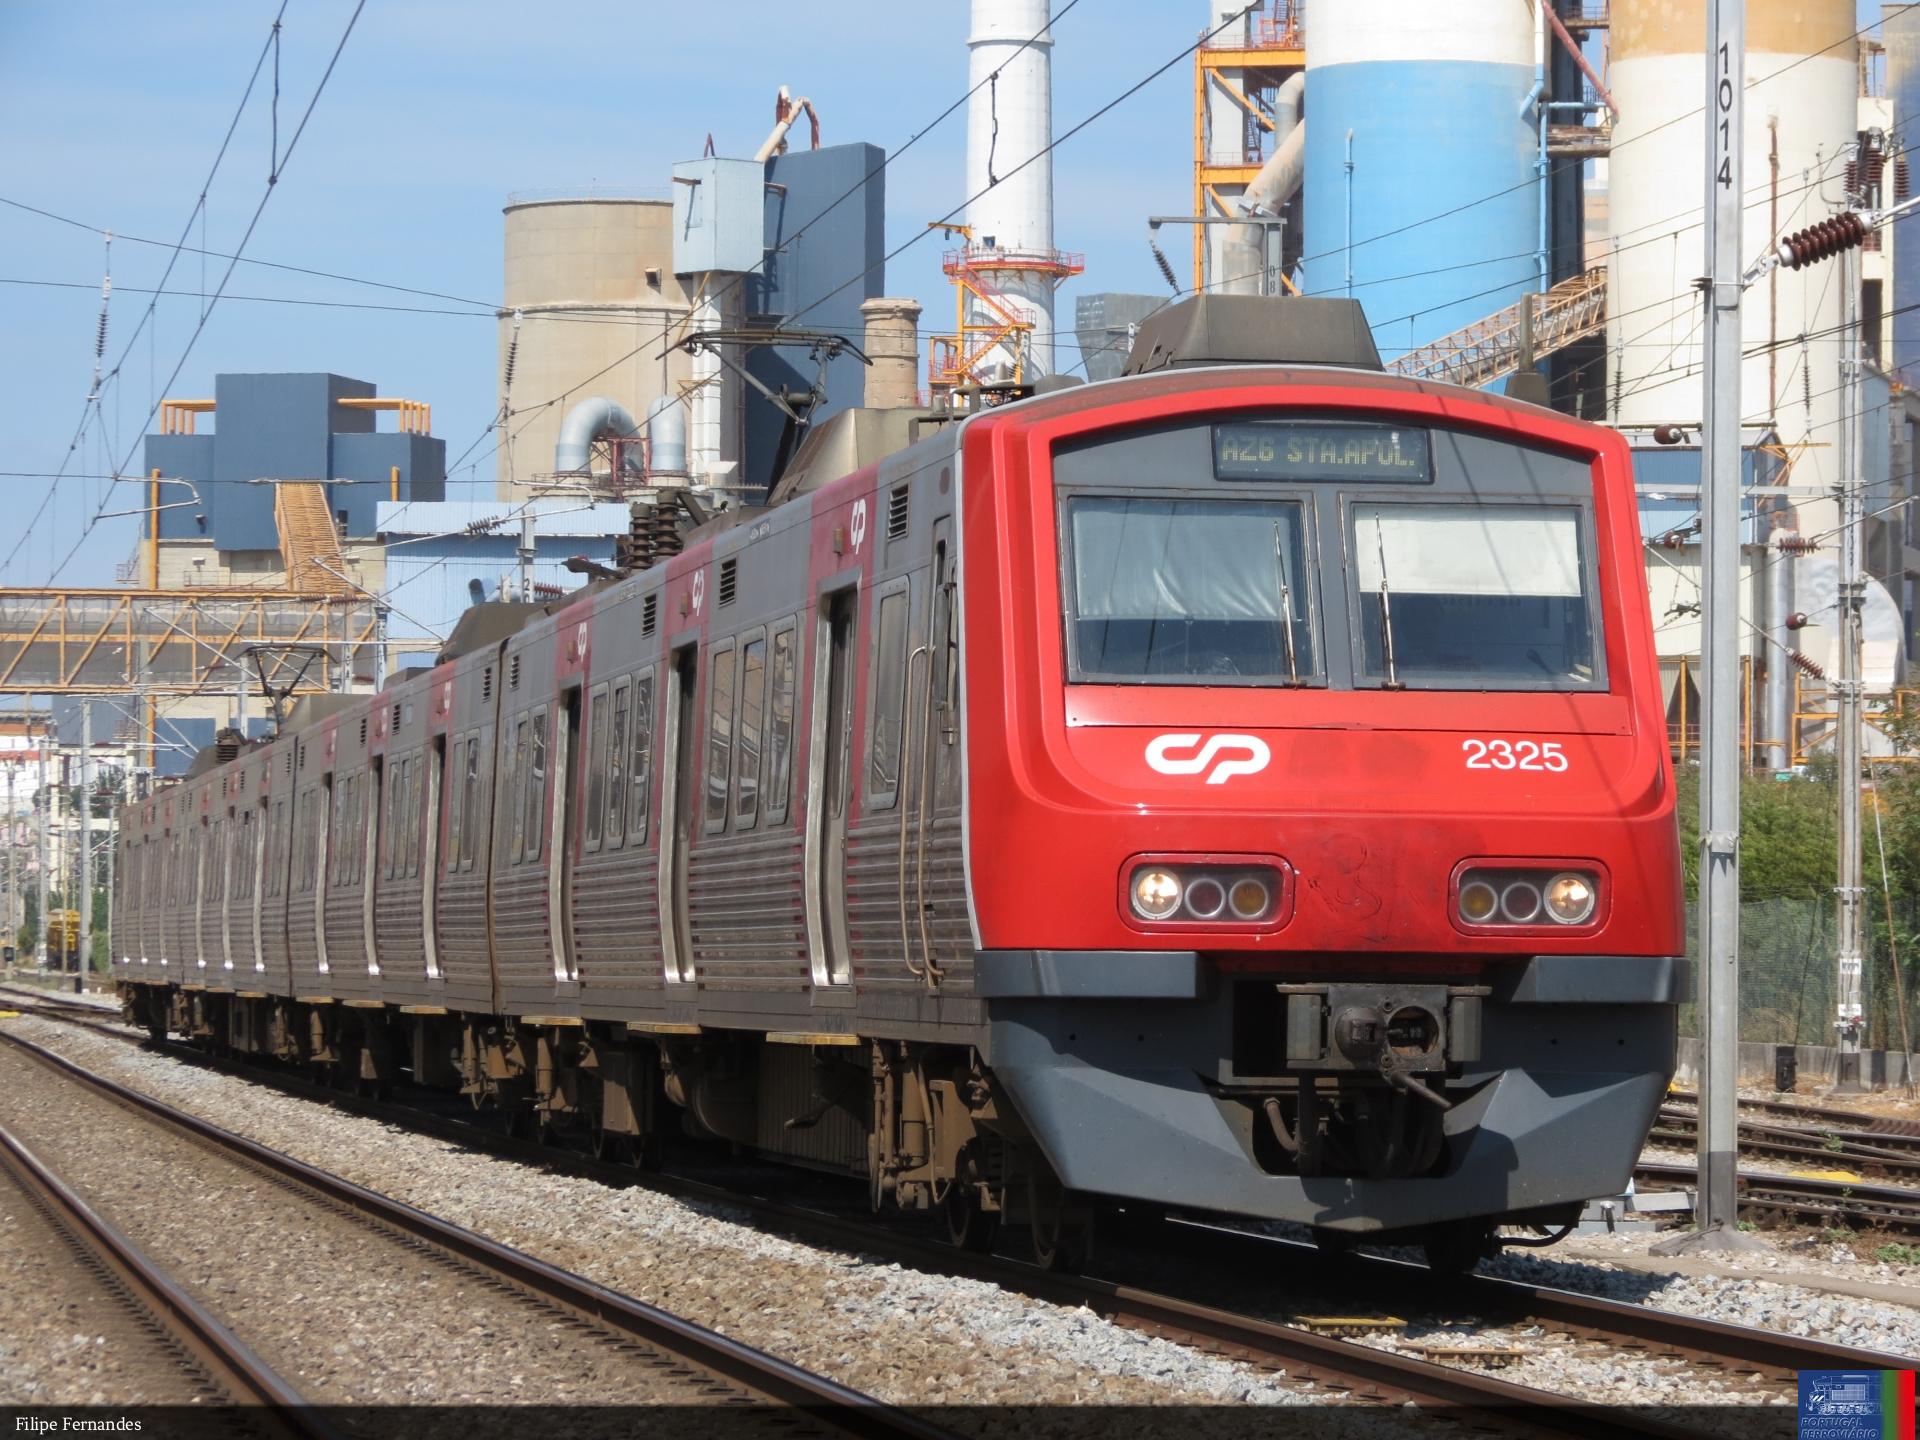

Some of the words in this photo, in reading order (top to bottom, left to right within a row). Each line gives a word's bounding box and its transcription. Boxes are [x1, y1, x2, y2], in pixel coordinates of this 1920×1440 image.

[1717, 42, 1733, 190] 1014
[1145, 733, 1271, 785] CP
[1462, 739, 1569, 773] 2325
